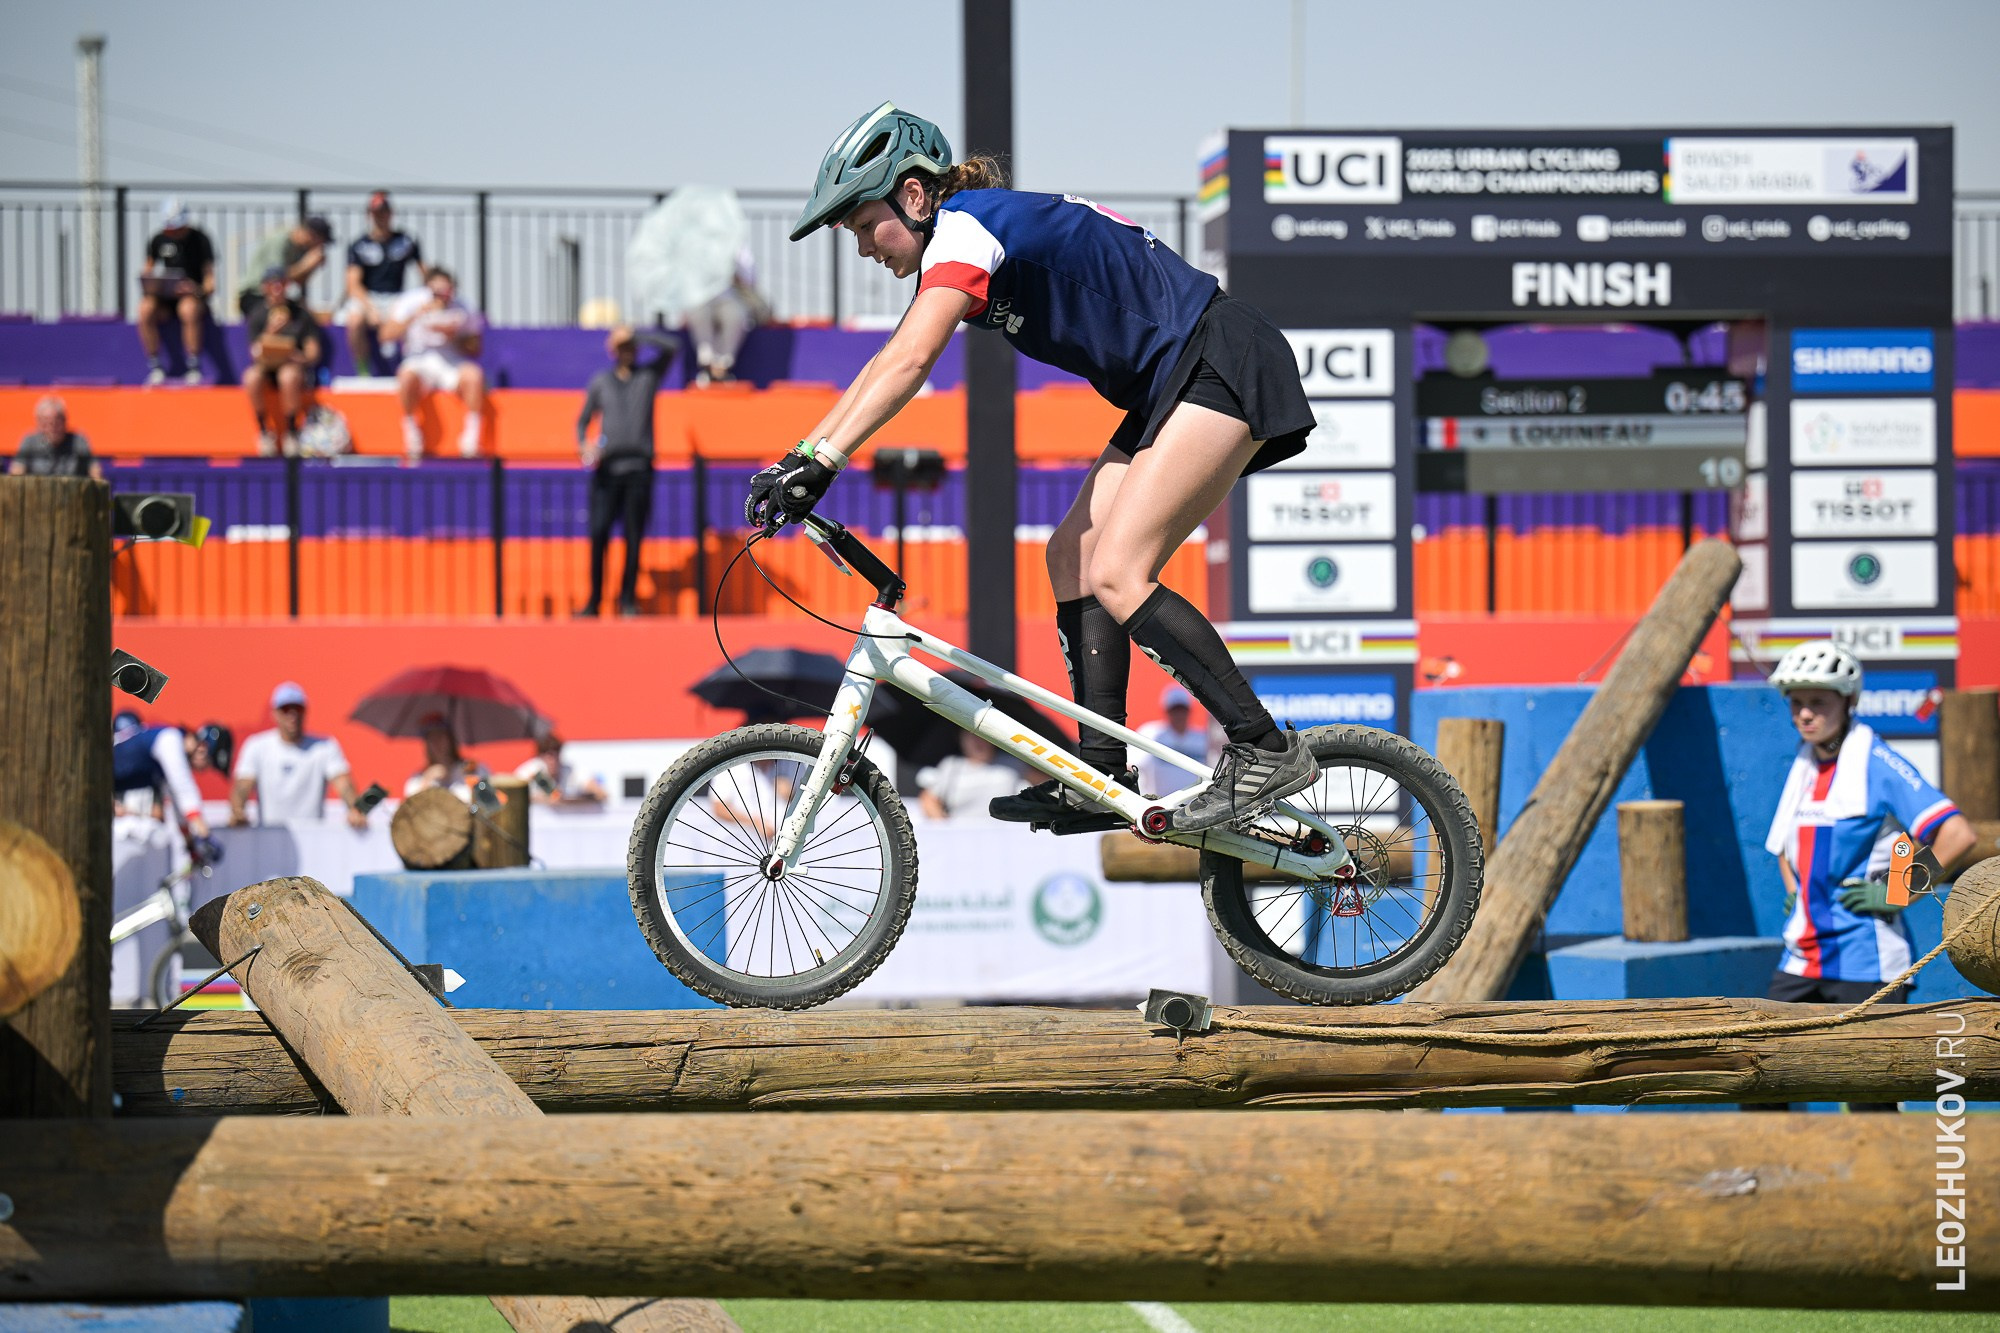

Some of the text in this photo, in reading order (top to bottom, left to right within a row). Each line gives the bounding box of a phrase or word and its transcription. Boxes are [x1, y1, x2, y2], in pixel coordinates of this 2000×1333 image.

[1293, 153, 1385, 187] UCI
[1455, 148, 1528, 171] URBAN
[1529, 148, 1620, 171] CYCLING
[1406, 171, 1659, 193] WORLD CHAMPIONSHIPS
[1511, 262, 1672, 307] FINISH
[1793, 346, 1933, 375] SHIMANO
[1480, 384, 1588, 415] Section 2
[1664, 381, 1747, 414] 0:45
[1509, 424, 1653, 446] LOUINEAU
[1699, 457, 1744, 487] 10
[1271, 503, 1372, 524] TISSOT
[1813, 500, 1914, 521] TISSOT
[1294, 630, 1353, 654] UCI
[1834, 624, 1894, 649] UCI
